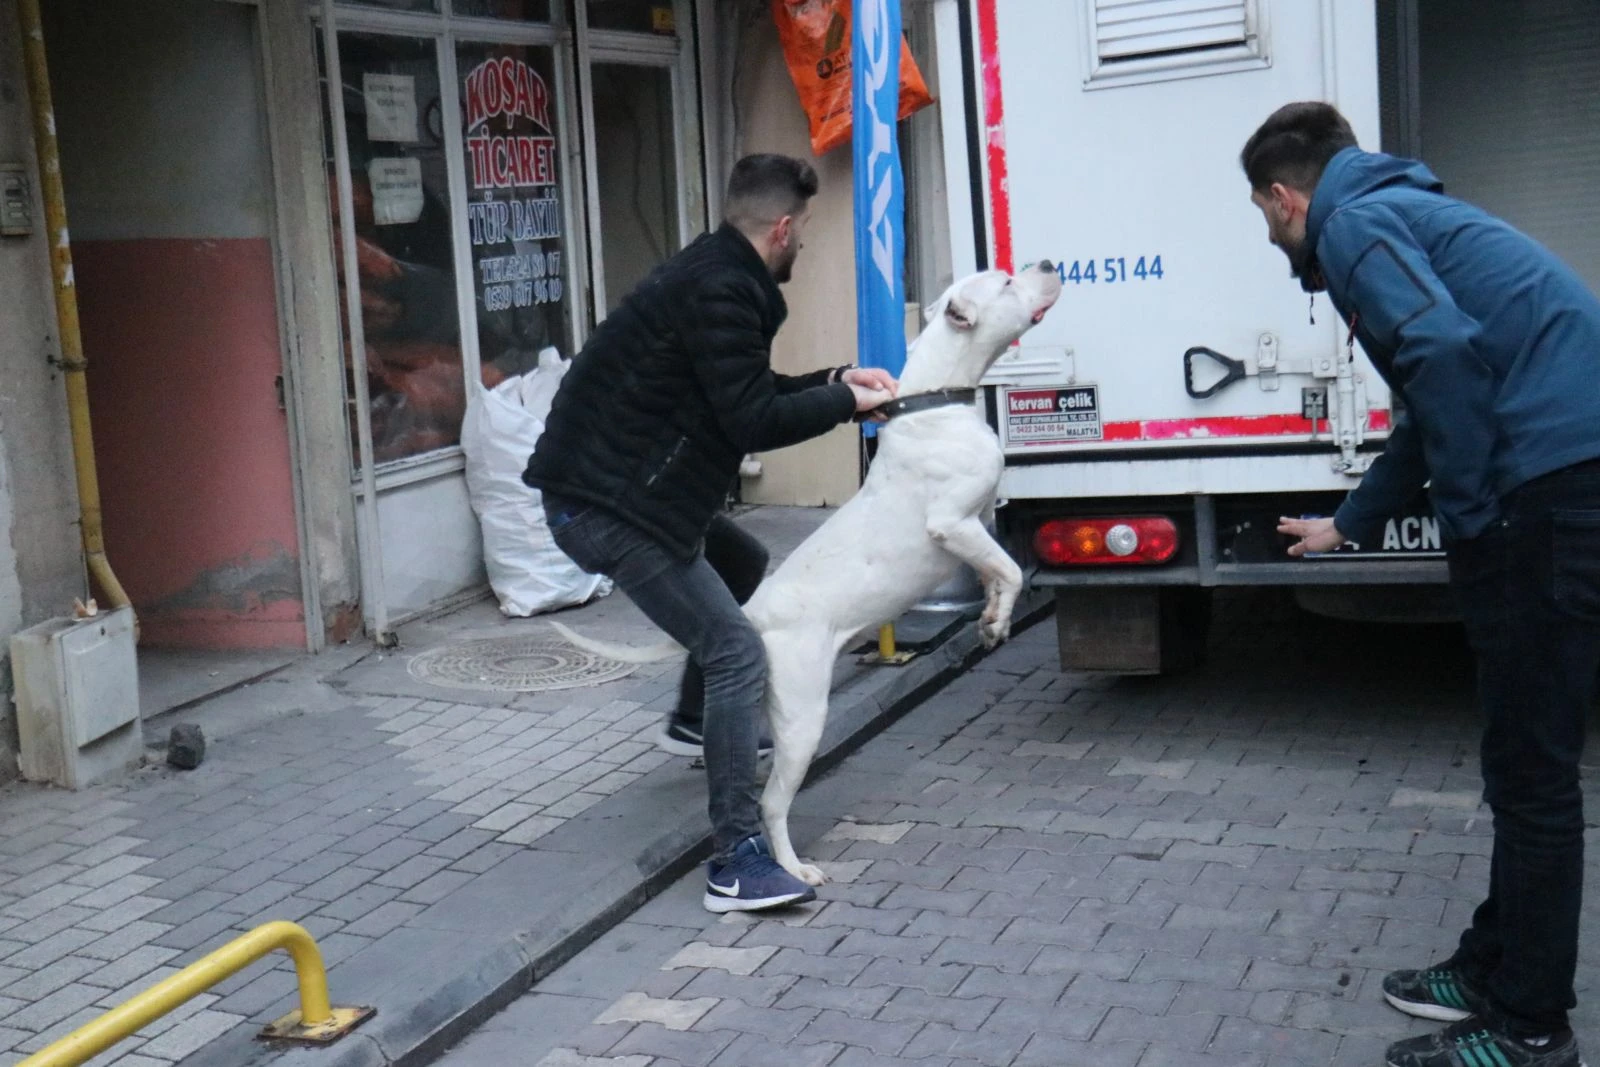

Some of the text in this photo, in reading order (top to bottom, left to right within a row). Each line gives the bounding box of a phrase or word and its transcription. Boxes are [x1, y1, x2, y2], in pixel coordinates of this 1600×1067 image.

[465, 56, 551, 134] KOŞAR
[467, 124, 555, 189] TİCARET
[469, 190, 509, 245] TÜP
[1104, 257, 1126, 283] 51
[1133, 255, 1164, 280] 44
[1010, 392, 1093, 412] kervan çelik
[1066, 428, 1098, 436] MALATYA
[1382, 516, 1441, 550] ACN
